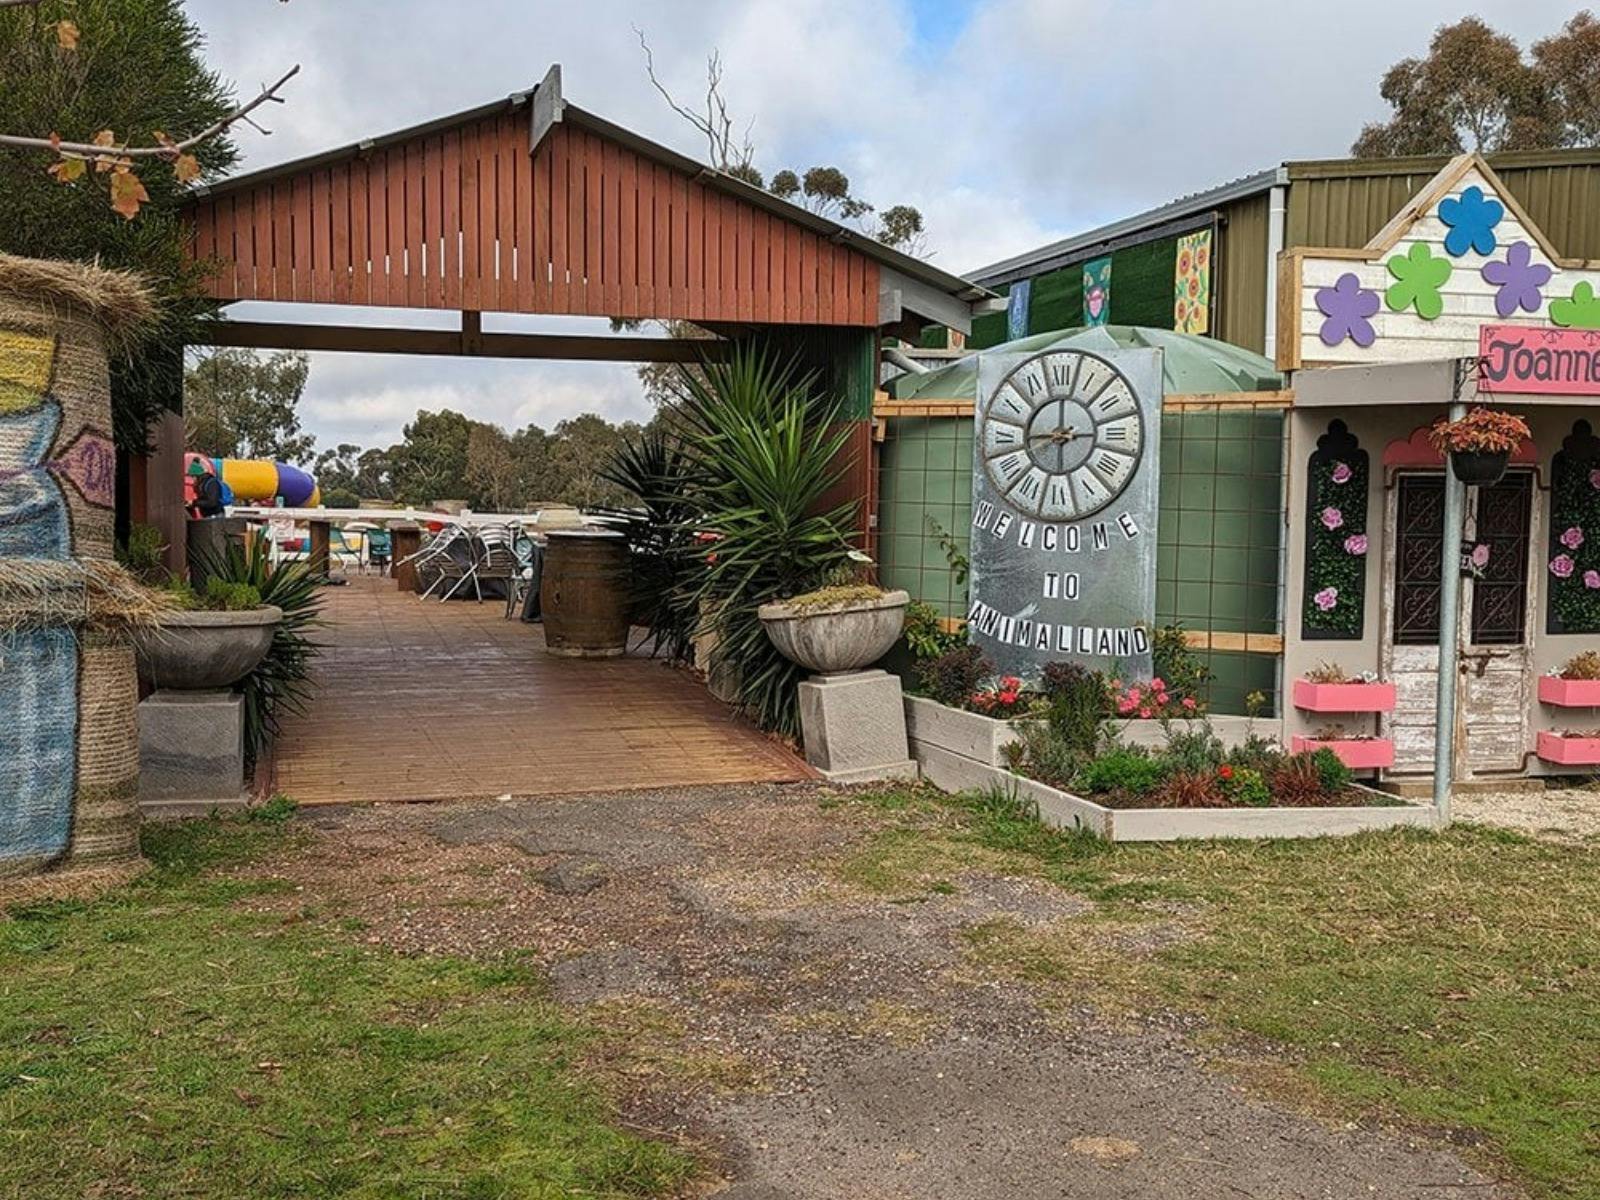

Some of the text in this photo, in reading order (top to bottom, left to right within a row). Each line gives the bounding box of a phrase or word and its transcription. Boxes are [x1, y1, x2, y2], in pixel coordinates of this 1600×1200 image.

[974, 502, 1138, 551] WELCOME
[1047, 573, 1078, 599] TO
[968, 603, 1148, 655] ANIMALLAND
